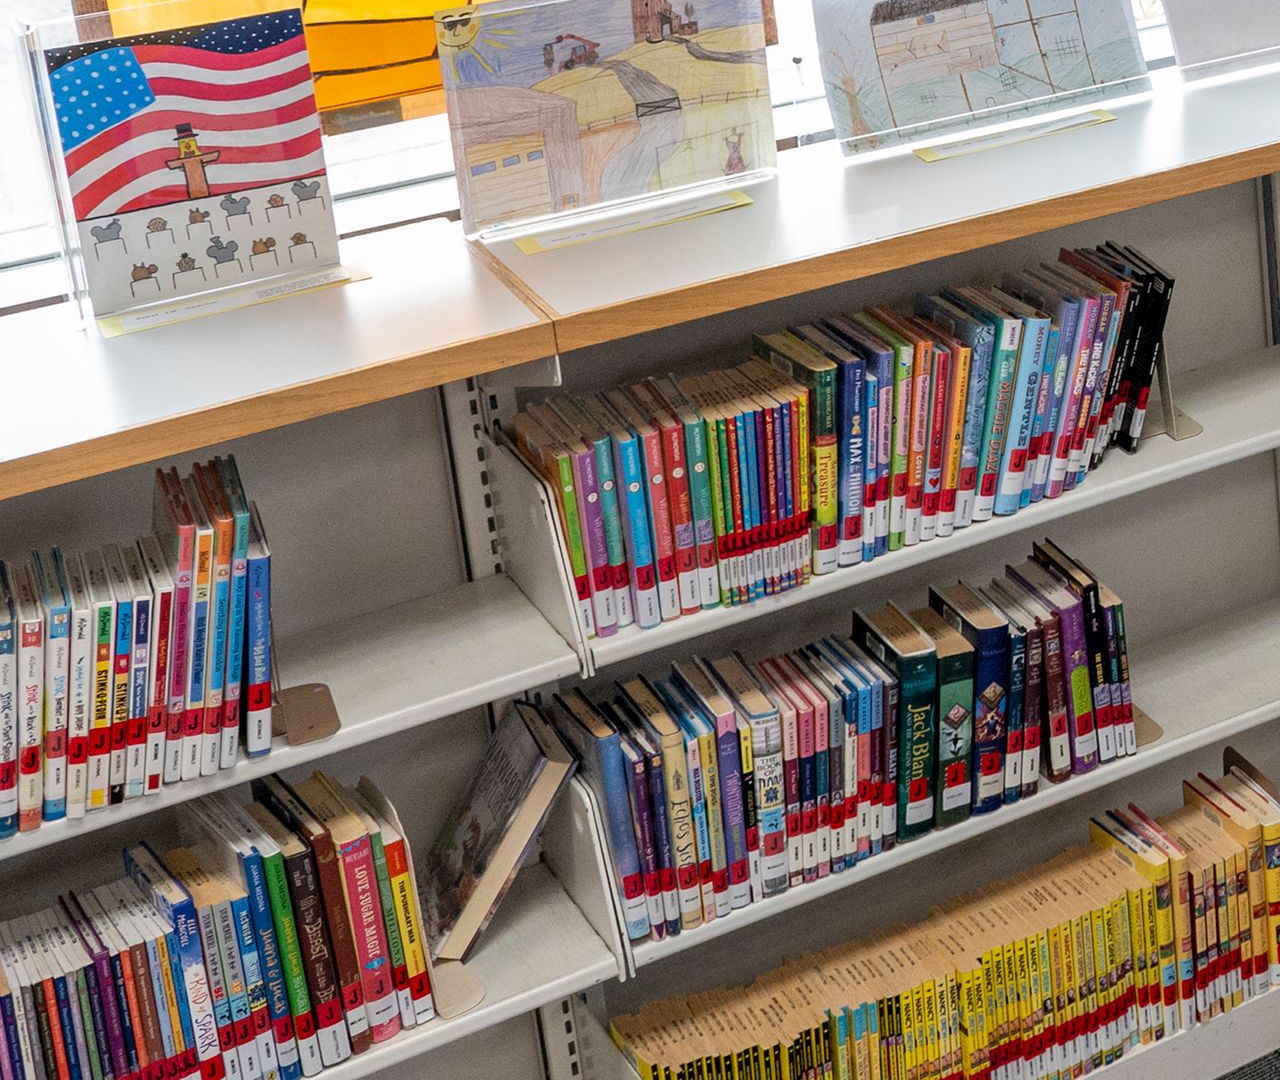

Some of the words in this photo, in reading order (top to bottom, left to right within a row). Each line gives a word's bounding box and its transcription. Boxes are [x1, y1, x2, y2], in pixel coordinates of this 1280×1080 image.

[850, 438, 862, 463] MAX
[250, 864, 259, 886] JUANA
[354, 864, 368, 892] LOVE
[253, 886, 265, 912] MEDINA
[358, 893, 374, 930] SUGAR
[400, 895, 413, 930] PUSHCART
[407, 931, 416, 945] WAR
[364, 931, 381, 958] MAGIC
[195, 1014, 218, 1054] SPARK
